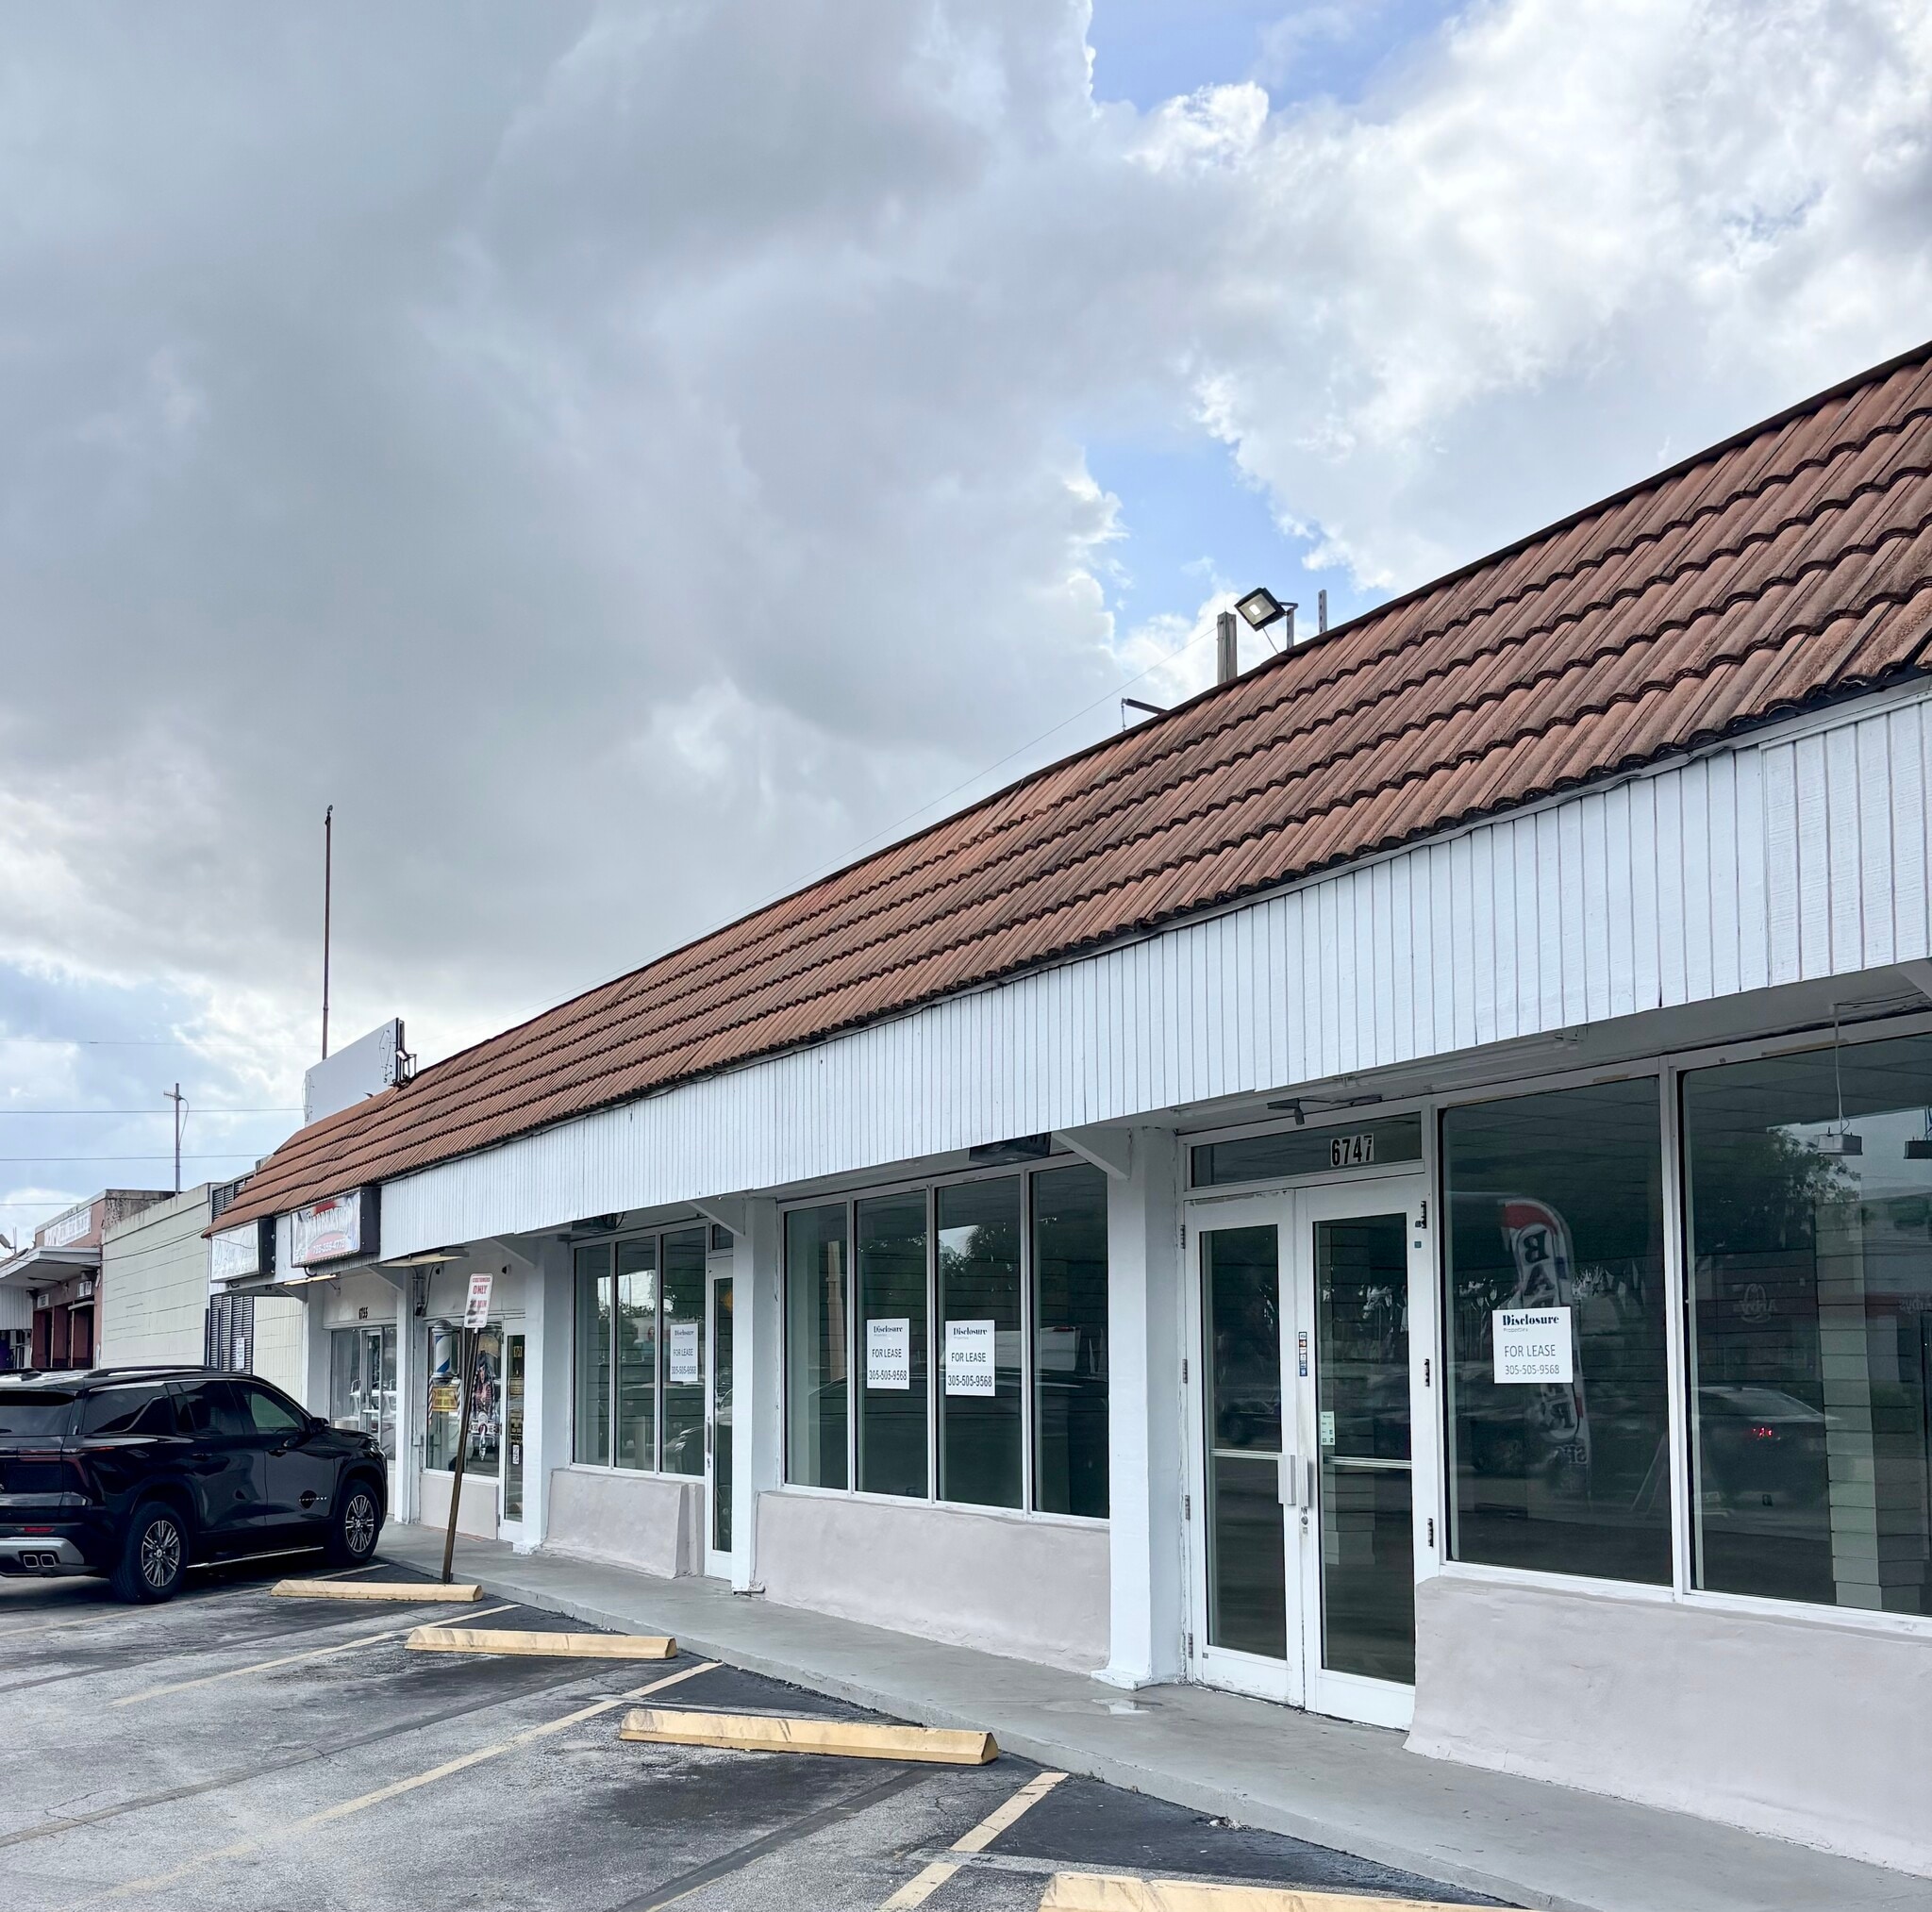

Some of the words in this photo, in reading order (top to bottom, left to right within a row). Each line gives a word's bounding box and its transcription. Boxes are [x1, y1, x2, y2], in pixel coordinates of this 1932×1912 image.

[1331, 1135, 1373, 1166] 6747
[473, 1285, 488, 1295] ONLY
[1502, 1313, 1559, 1326] Disclosure
[874, 1325, 903, 1334] Disclosure
[953, 1326, 988, 1336] Disclosure
[872, 1349, 884, 1358] FOR
[884, 1348, 903, 1358] LEASE
[1505, 1345, 1524, 1357] FOR
[1526, 1344, 1557, 1357] LEASE
[951, 1353, 964, 1362] FOR
[965, 1353, 987, 1363] LEASE
[1505, 1364, 1560, 1375] 305-505-9568
[869, 1370, 908, 1381] 305-505-9568
[947, 1374, 992, 1388] 305-505-9568
